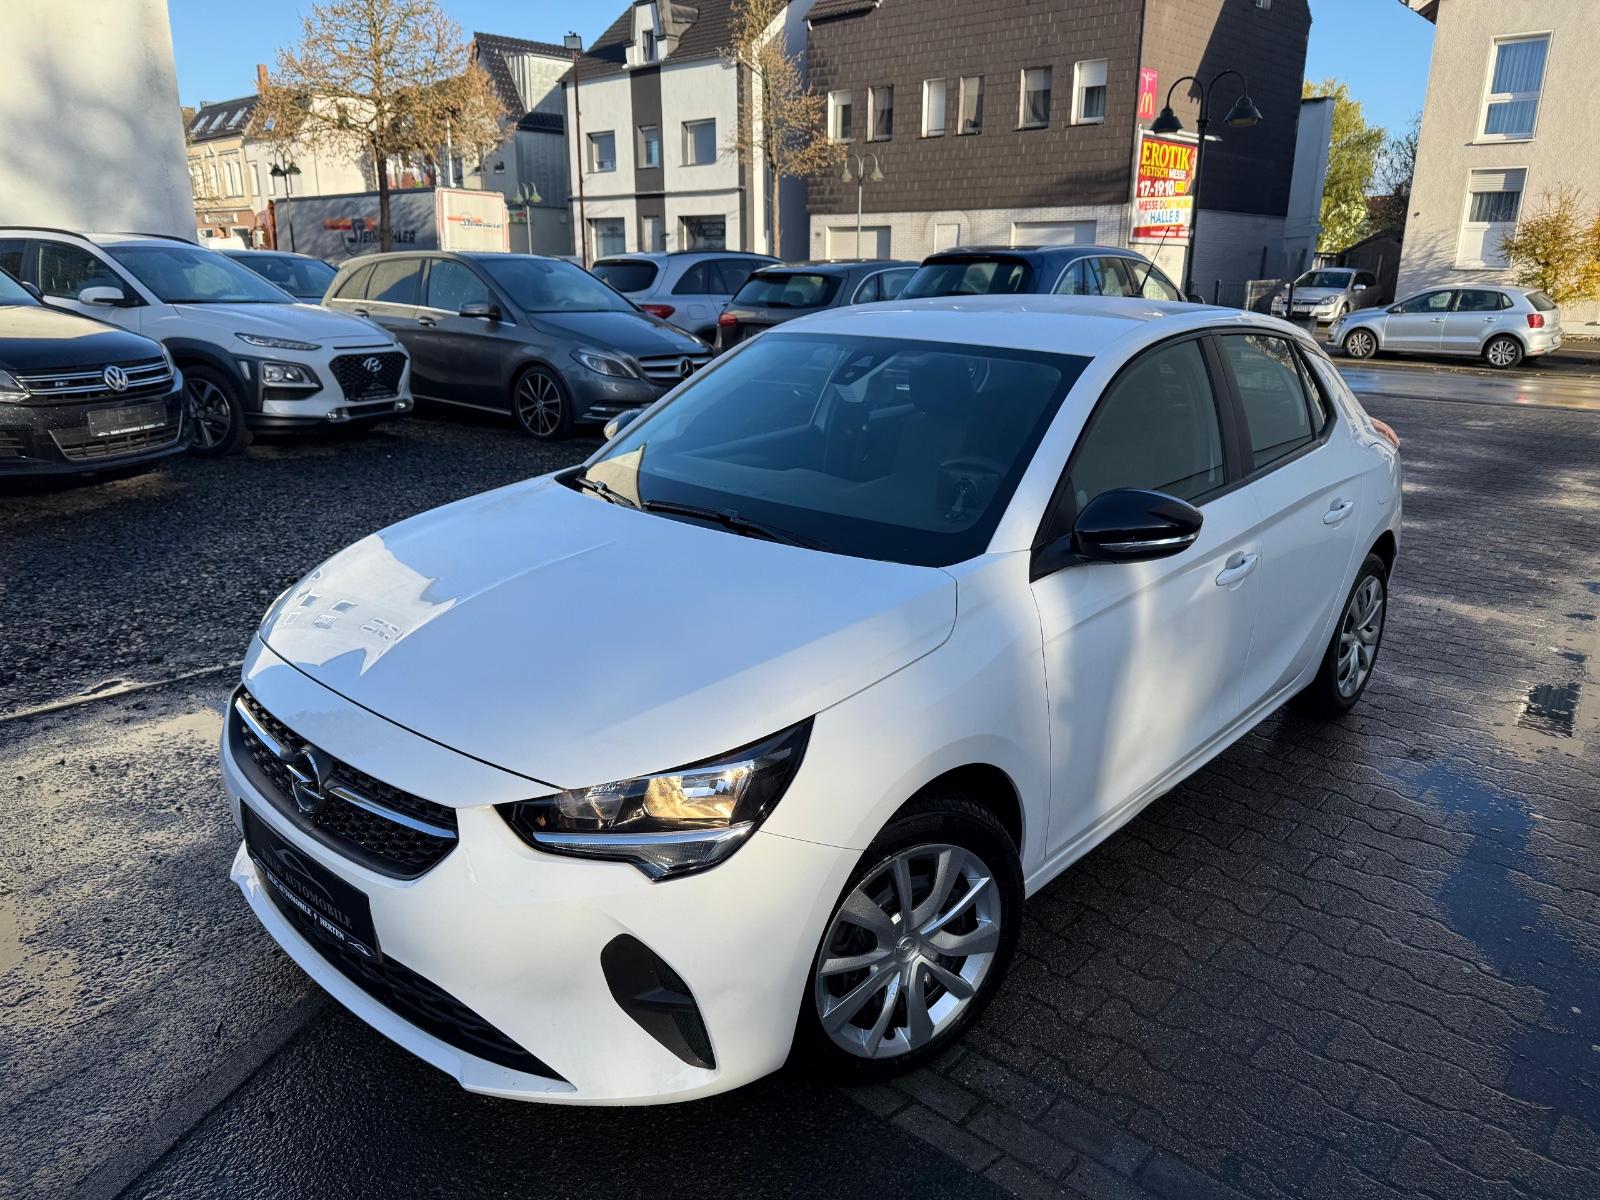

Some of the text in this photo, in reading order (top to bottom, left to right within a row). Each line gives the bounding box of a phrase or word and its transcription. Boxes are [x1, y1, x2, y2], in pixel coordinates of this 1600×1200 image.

[1141, 141, 1192, 170] EROTIK
[1138, 199, 1159, 211] MESSE
[1150, 209, 1180, 224] HALLE 8
[347, 218, 416, 244] STEINHLER
